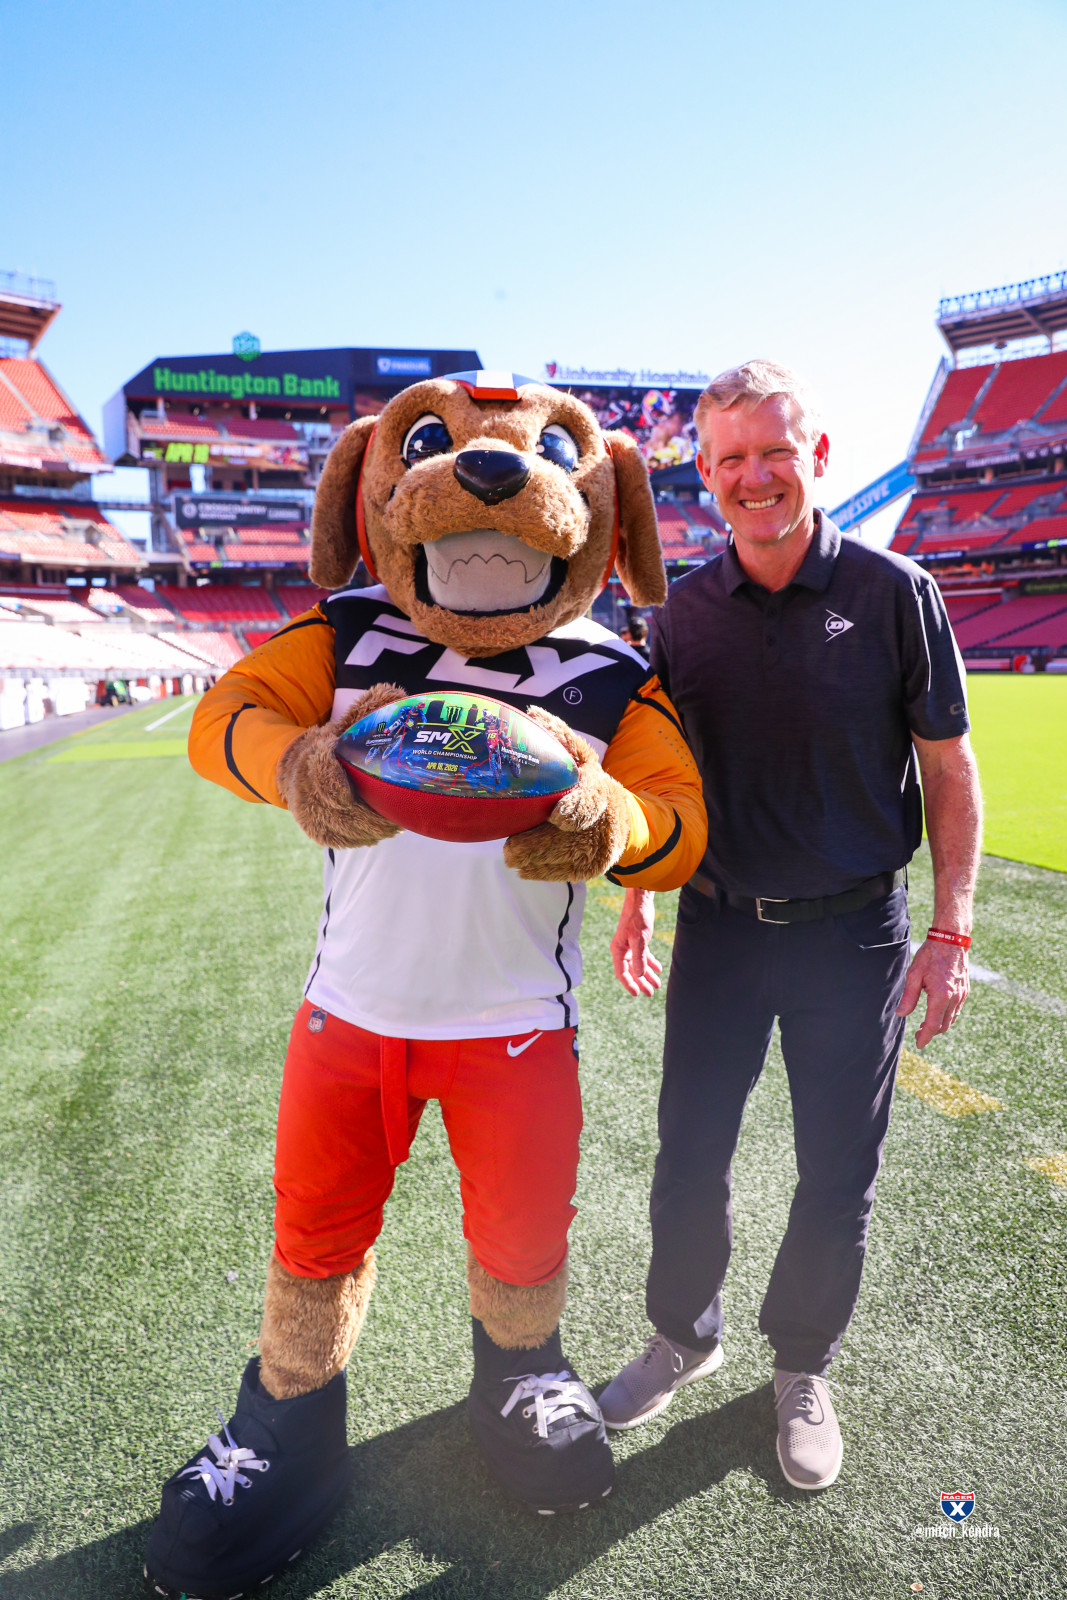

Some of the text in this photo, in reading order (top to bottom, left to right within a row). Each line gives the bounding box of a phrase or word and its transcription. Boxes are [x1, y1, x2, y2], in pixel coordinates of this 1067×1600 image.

[154, 367, 340, 399] Huntington Bank
[559, 365, 711, 386] University Hospitals
[413, 728, 481, 754] SMX
[432, 750, 478, 761] CHAMPIONSHIP
[426, 762, 437, 770] APR
[444, 764, 459, 773] 2026
